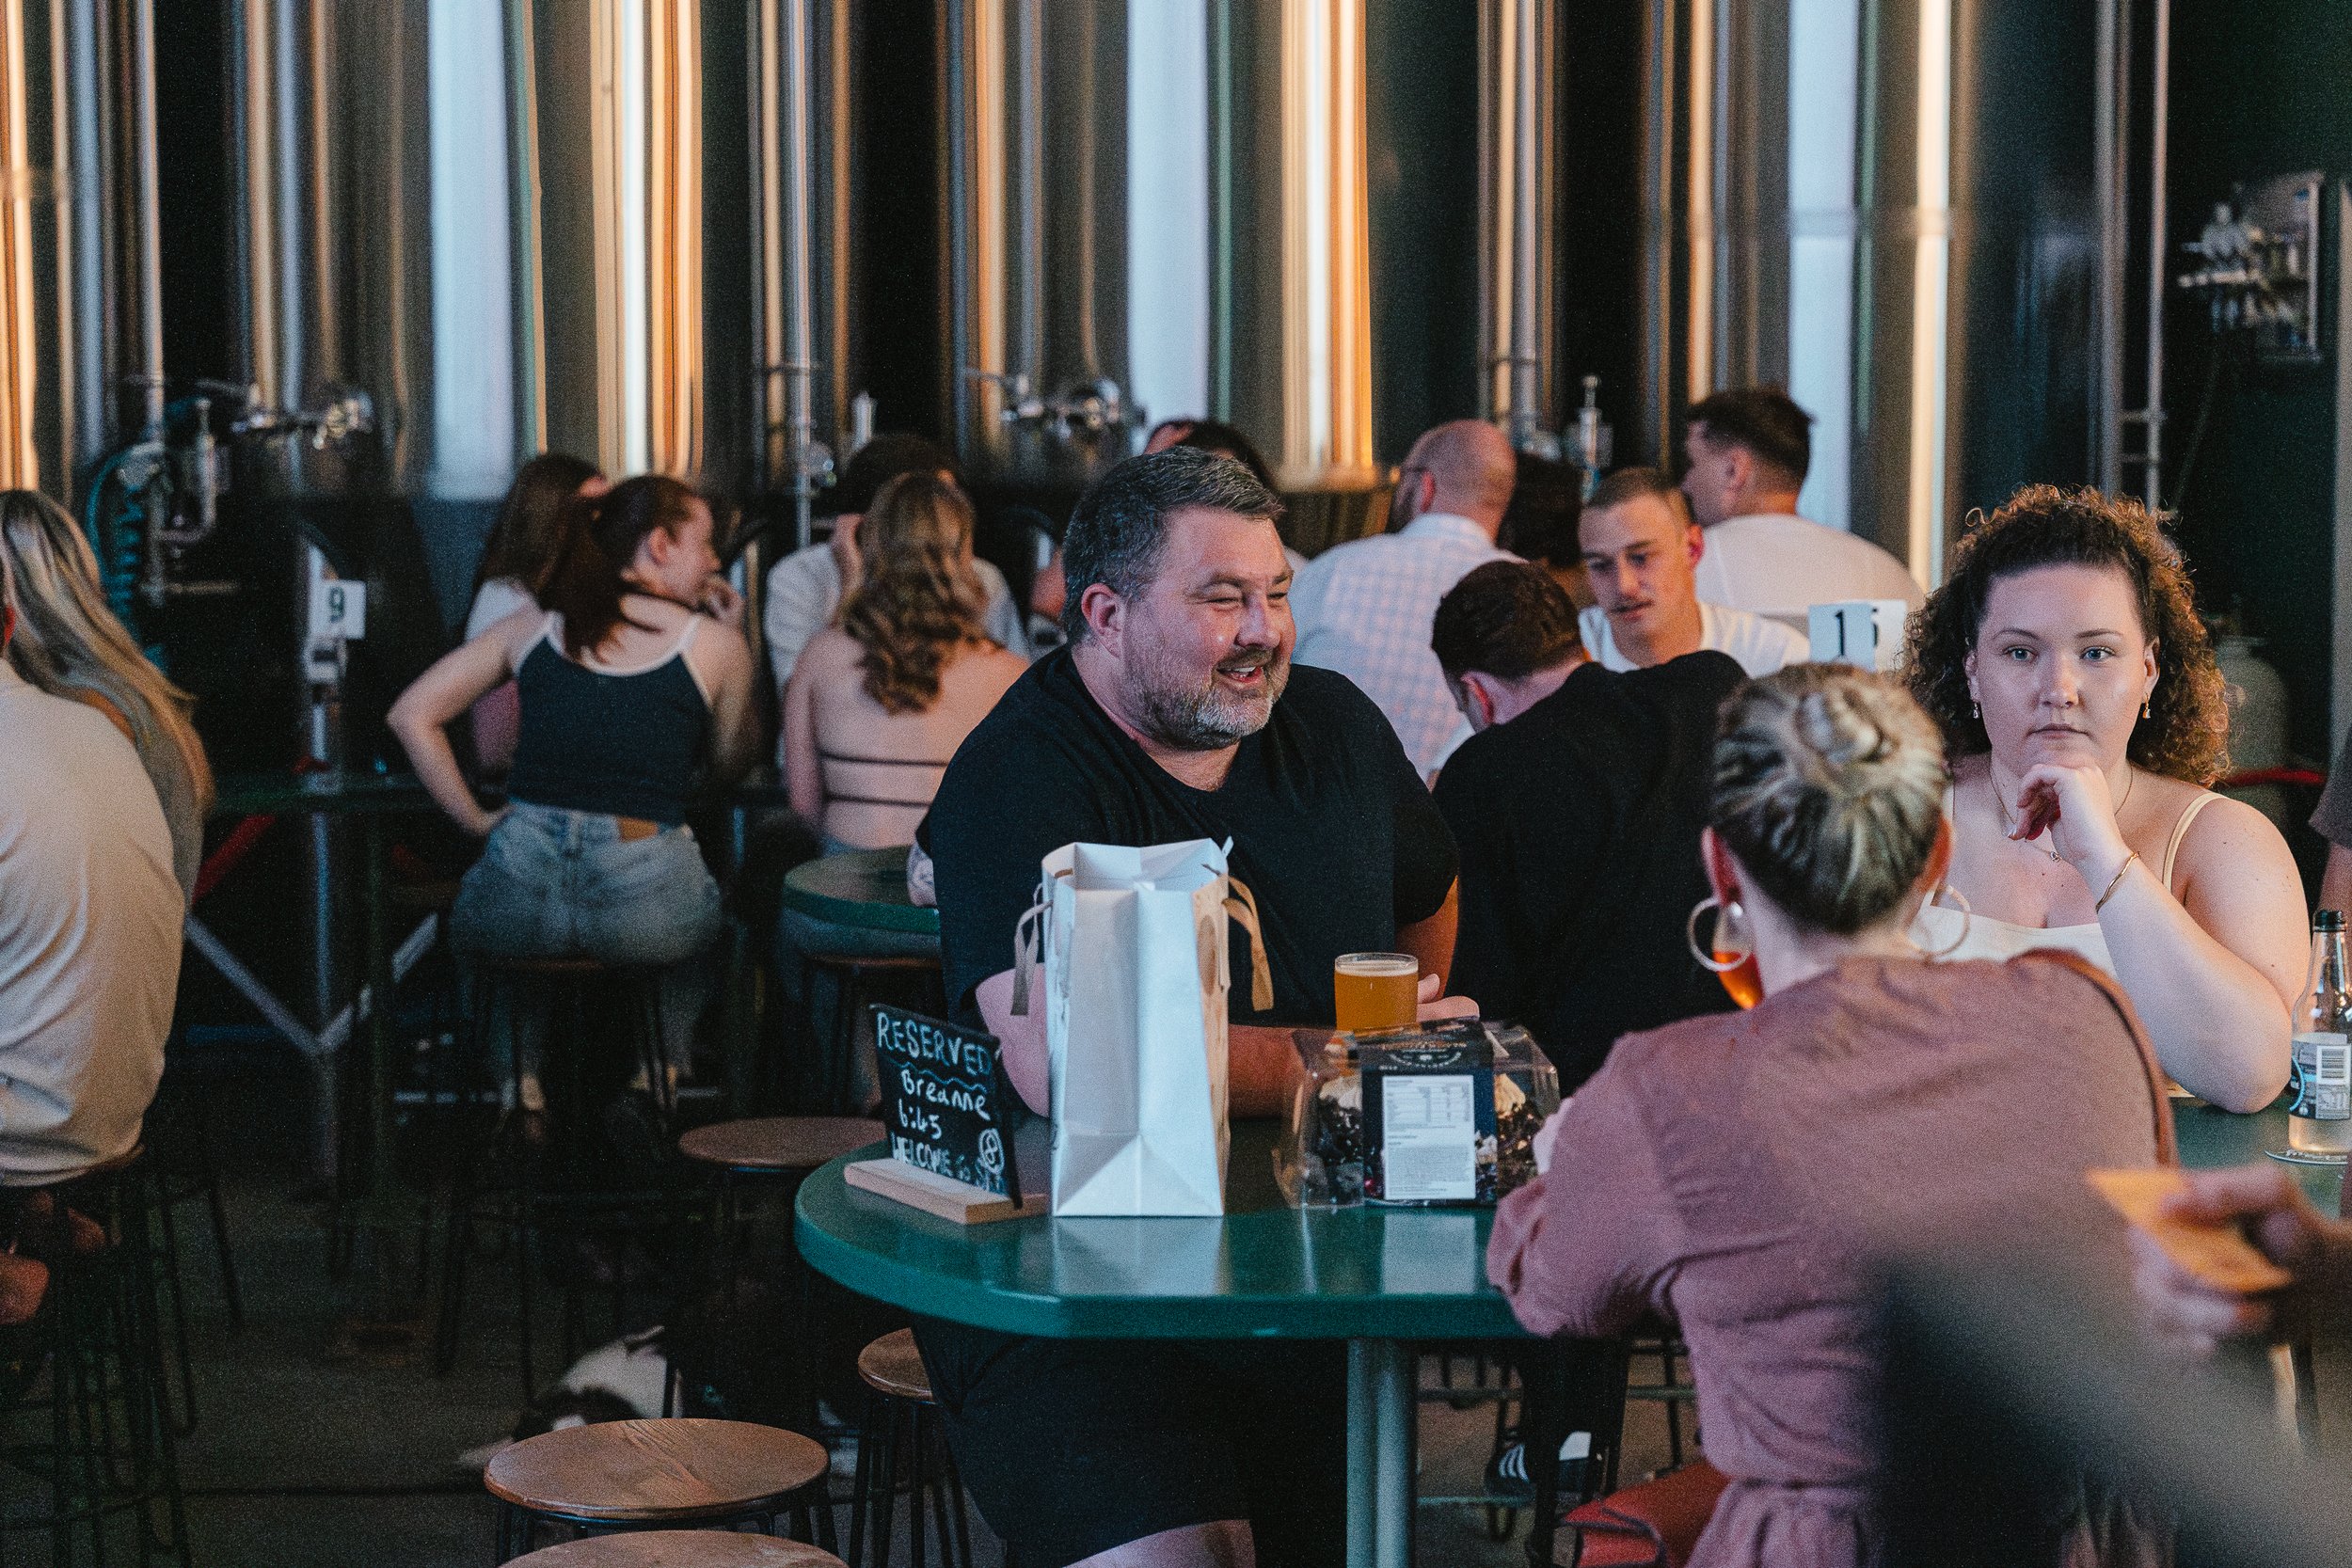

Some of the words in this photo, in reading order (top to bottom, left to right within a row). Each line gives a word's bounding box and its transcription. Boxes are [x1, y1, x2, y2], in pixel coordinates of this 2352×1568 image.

[329, 587, 345, 623] 9
[877, 1011, 992, 1076] RESERVED
[900, 1069, 991, 1121] Breanne
